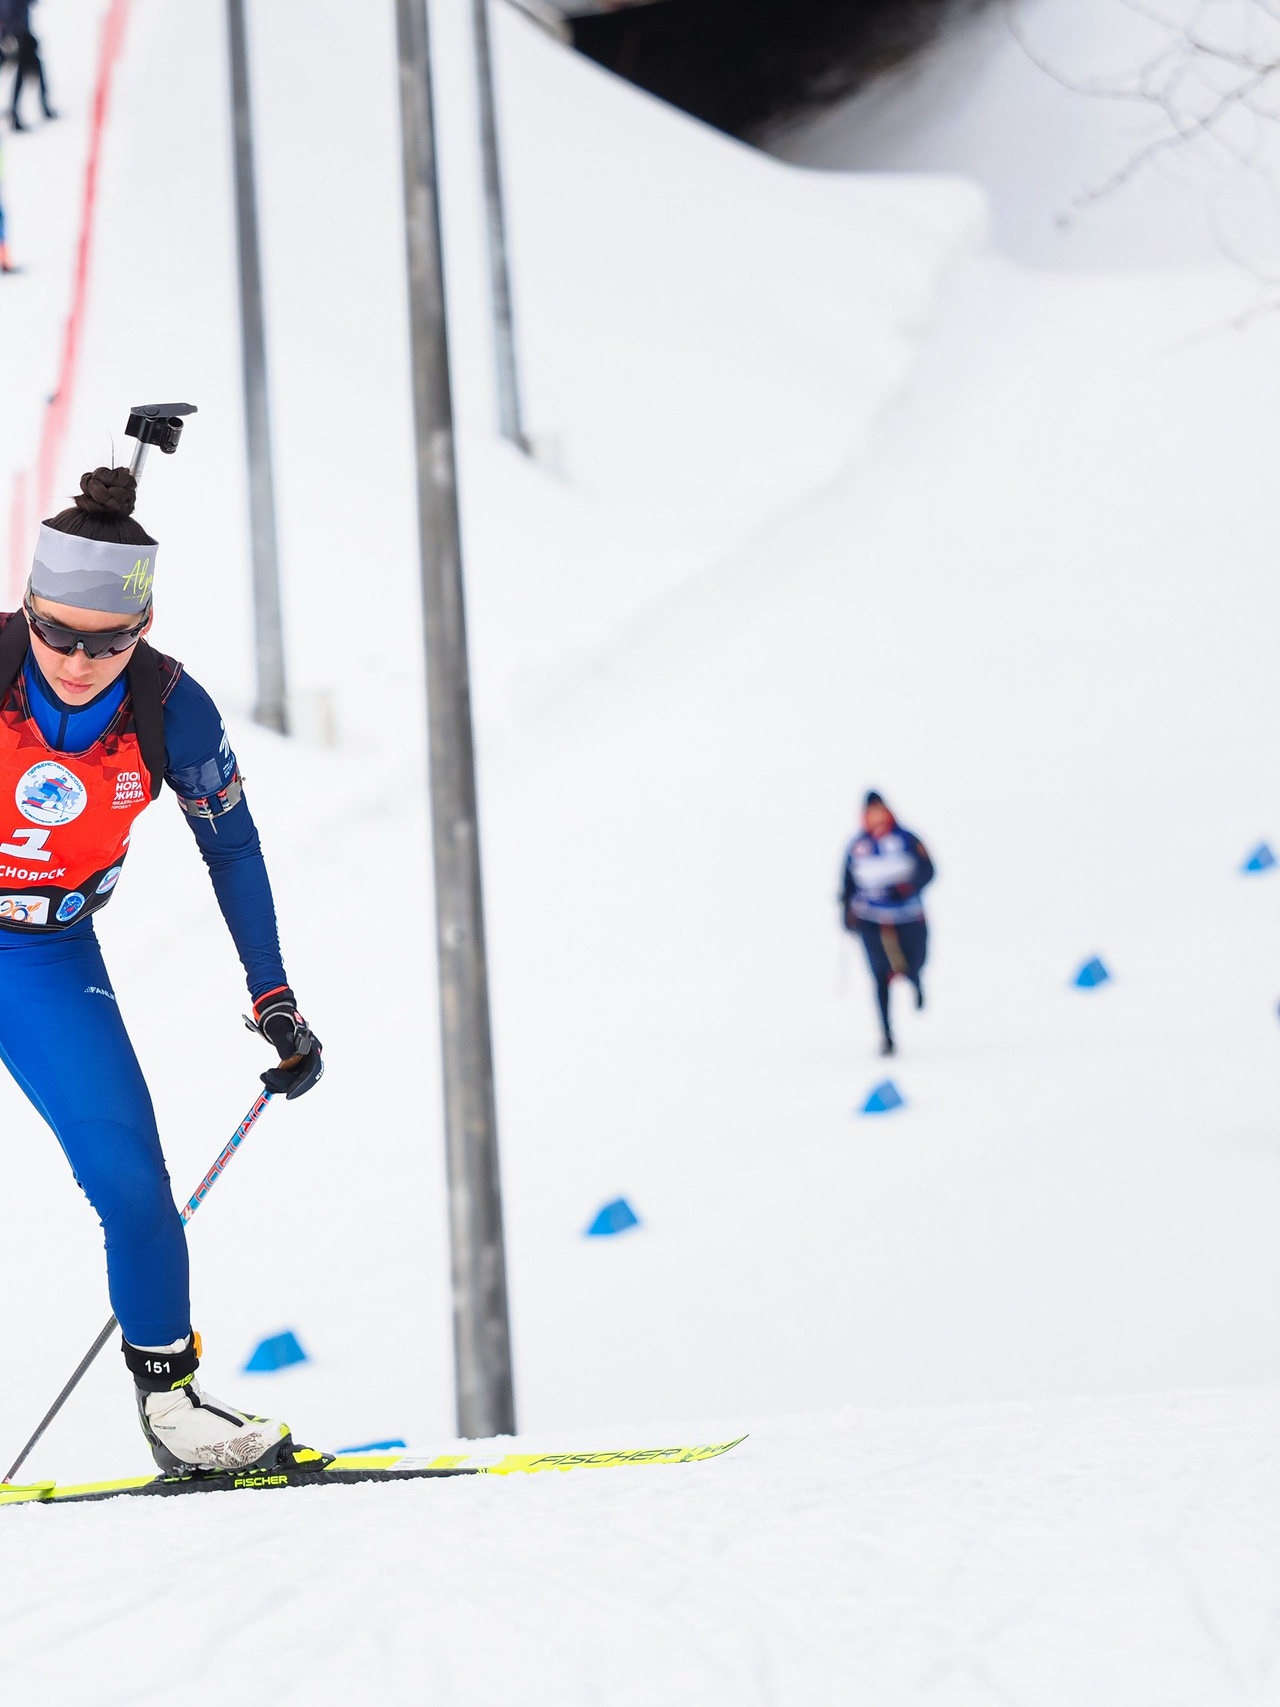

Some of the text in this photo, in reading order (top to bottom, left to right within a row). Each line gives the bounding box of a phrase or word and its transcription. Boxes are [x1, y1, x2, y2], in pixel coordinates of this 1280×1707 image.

[145, 1360, 171, 1374] 151
[529, 1448, 682, 1466] FISCHER
[234, 1475, 288, 1488] FISCHER
